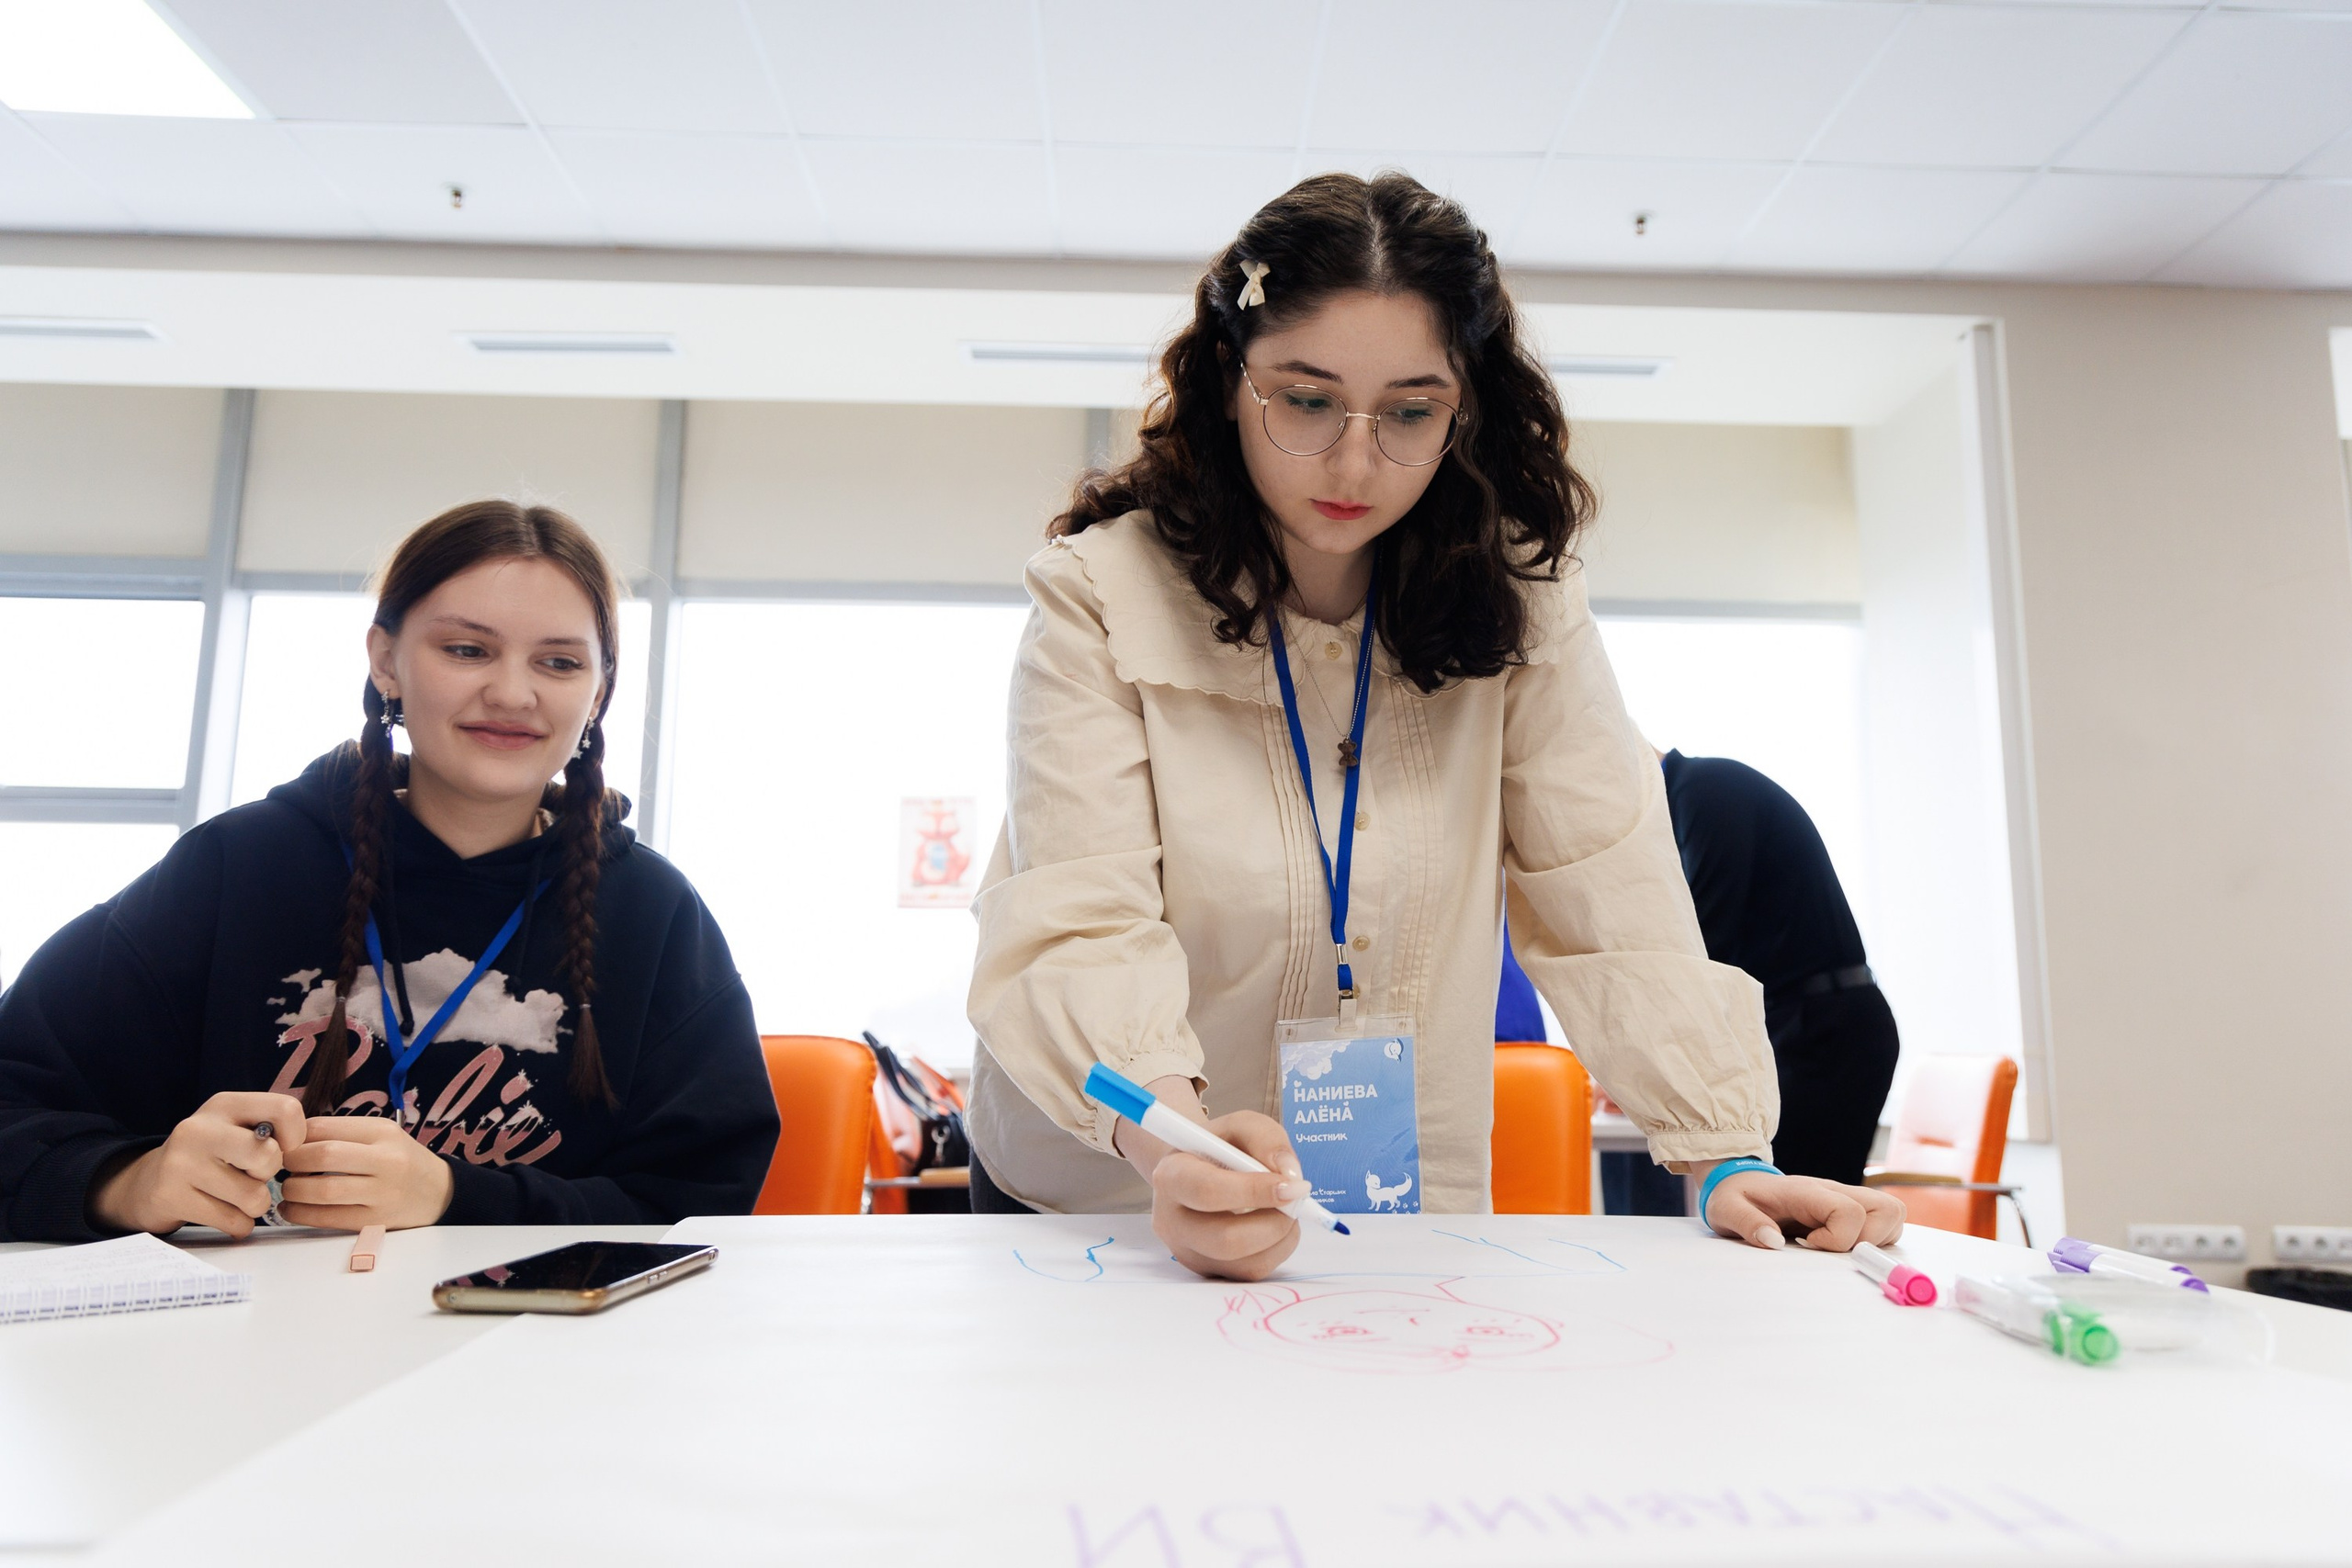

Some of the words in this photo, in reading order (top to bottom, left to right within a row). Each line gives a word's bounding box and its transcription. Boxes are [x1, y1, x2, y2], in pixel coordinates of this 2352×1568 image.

[1294, 1084, 1378, 1102] НАНИЕВА
[1294, 1104, 1354, 1124] АЛЁНА
[1295, 1133, 1348, 1144] Участник
